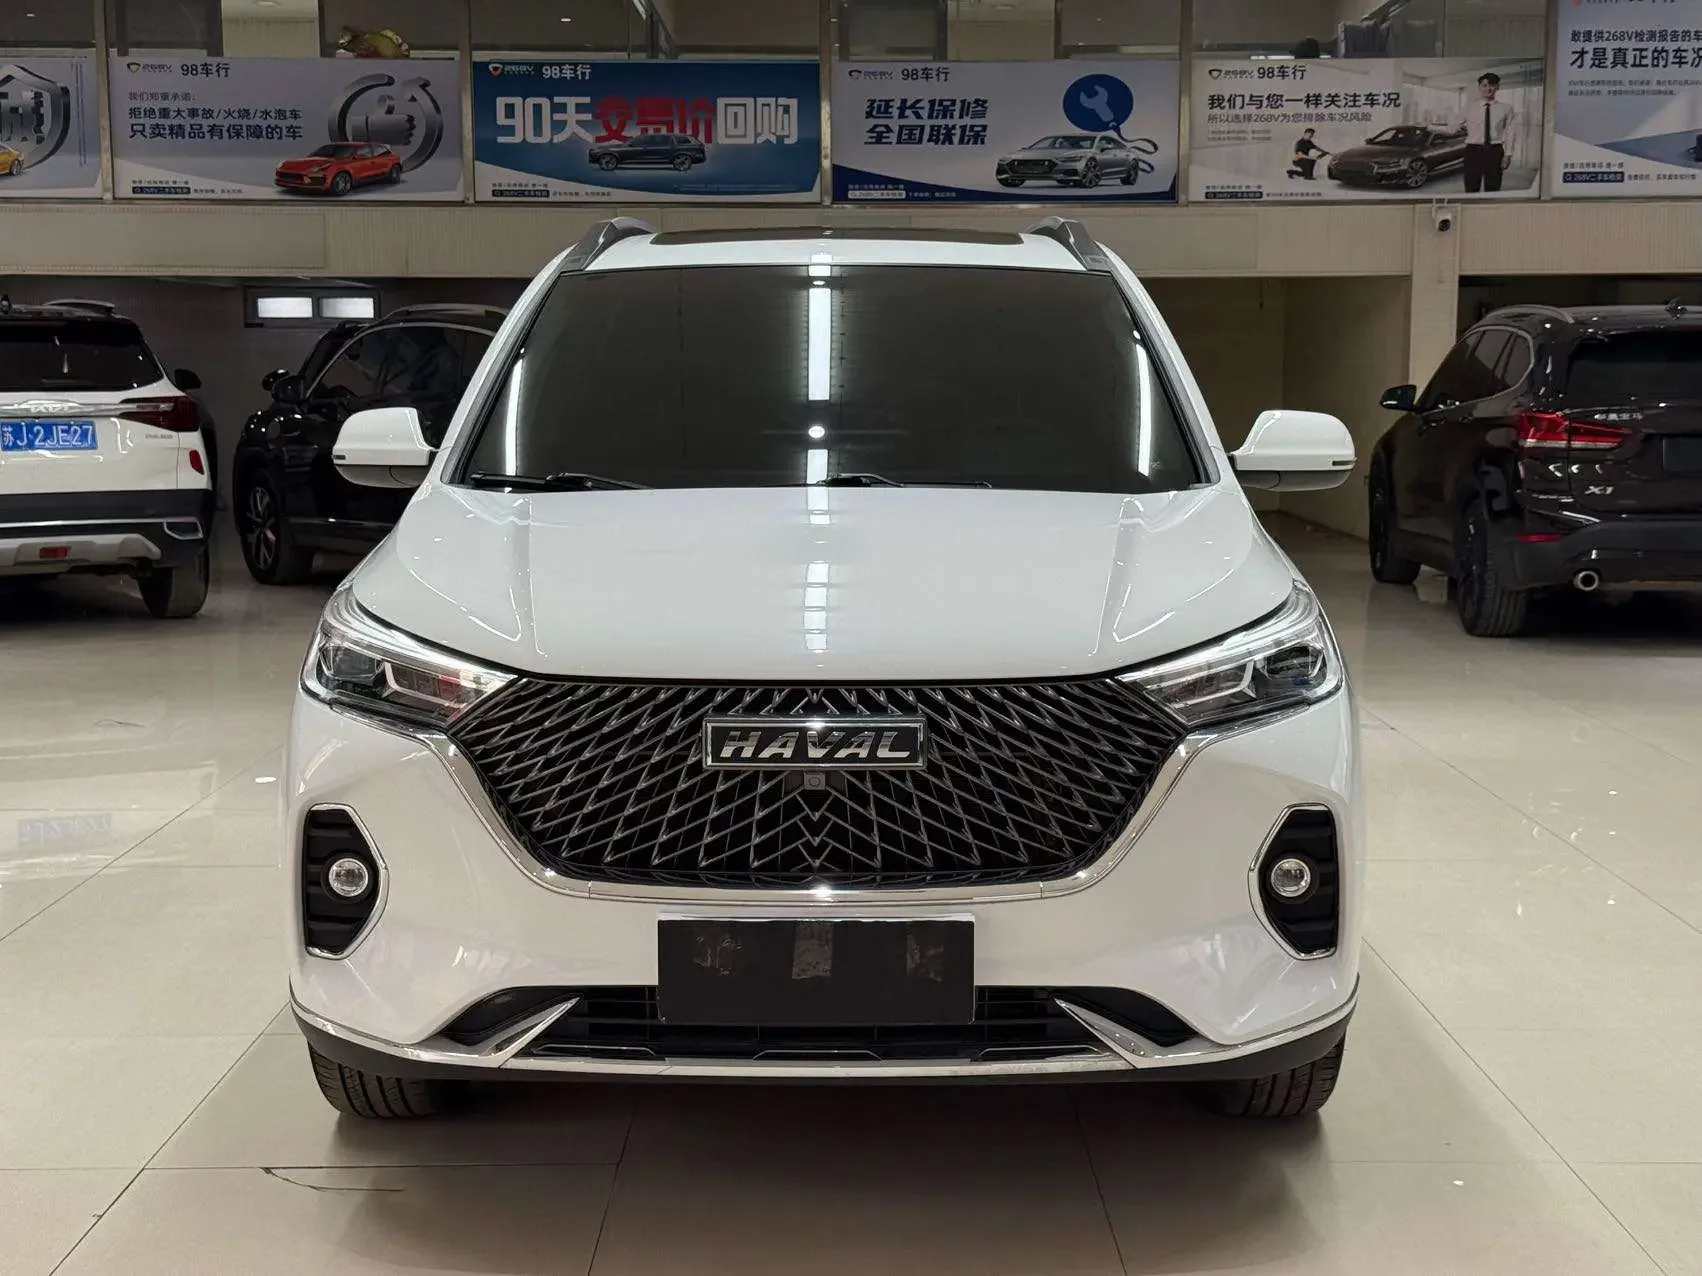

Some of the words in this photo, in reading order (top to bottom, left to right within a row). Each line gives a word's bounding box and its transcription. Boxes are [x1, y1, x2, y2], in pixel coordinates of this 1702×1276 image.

[181, 62, 230, 77] 98车行
[543, 64, 592, 80] 98车行
[901, 66, 950, 82] 98车行
[1257, 65, 1306, 80] 98车行
[865, 98, 988, 120] 延长保修
[1208, 92, 1401, 110] 我们与您一样关注车况
[129, 124, 303, 141] 只卖精品有保障的车
[864, 124, 988, 145] 全国联保
[1585, 486, 1614, 495] X1
[720, 731, 911, 758] HAVAL
